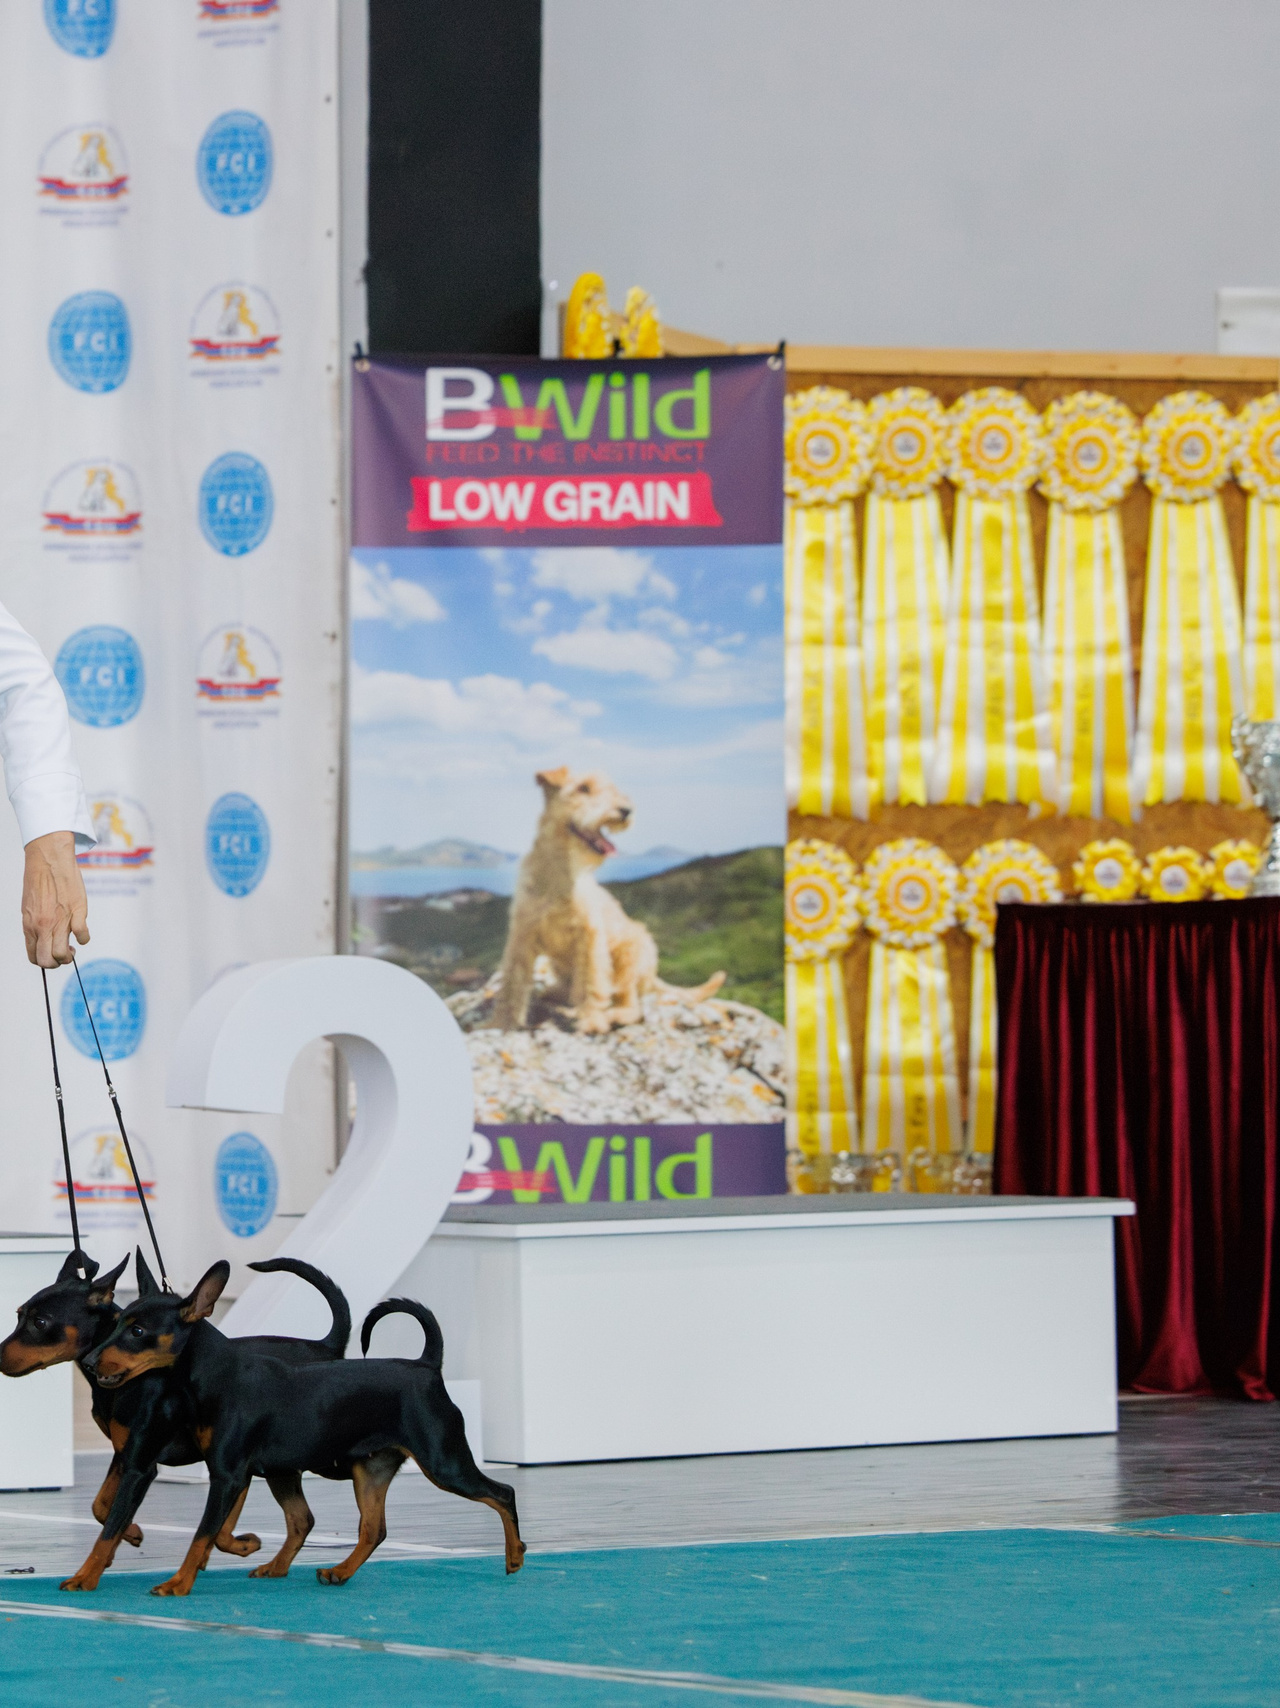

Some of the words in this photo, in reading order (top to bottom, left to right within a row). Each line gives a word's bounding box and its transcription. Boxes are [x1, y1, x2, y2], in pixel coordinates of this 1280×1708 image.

[73, 332, 120, 351] FCI
[425, 366, 712, 441] BWild
[425, 442, 501, 464] FEED
[509, 442, 565, 464] THE
[573, 441, 706, 463] INSTINCT
[428, 481, 536, 521] LOW
[543, 480, 690, 520] GRAIN
[80, 668, 126, 687] FCI
[167, 955, 482, 1460] 2
